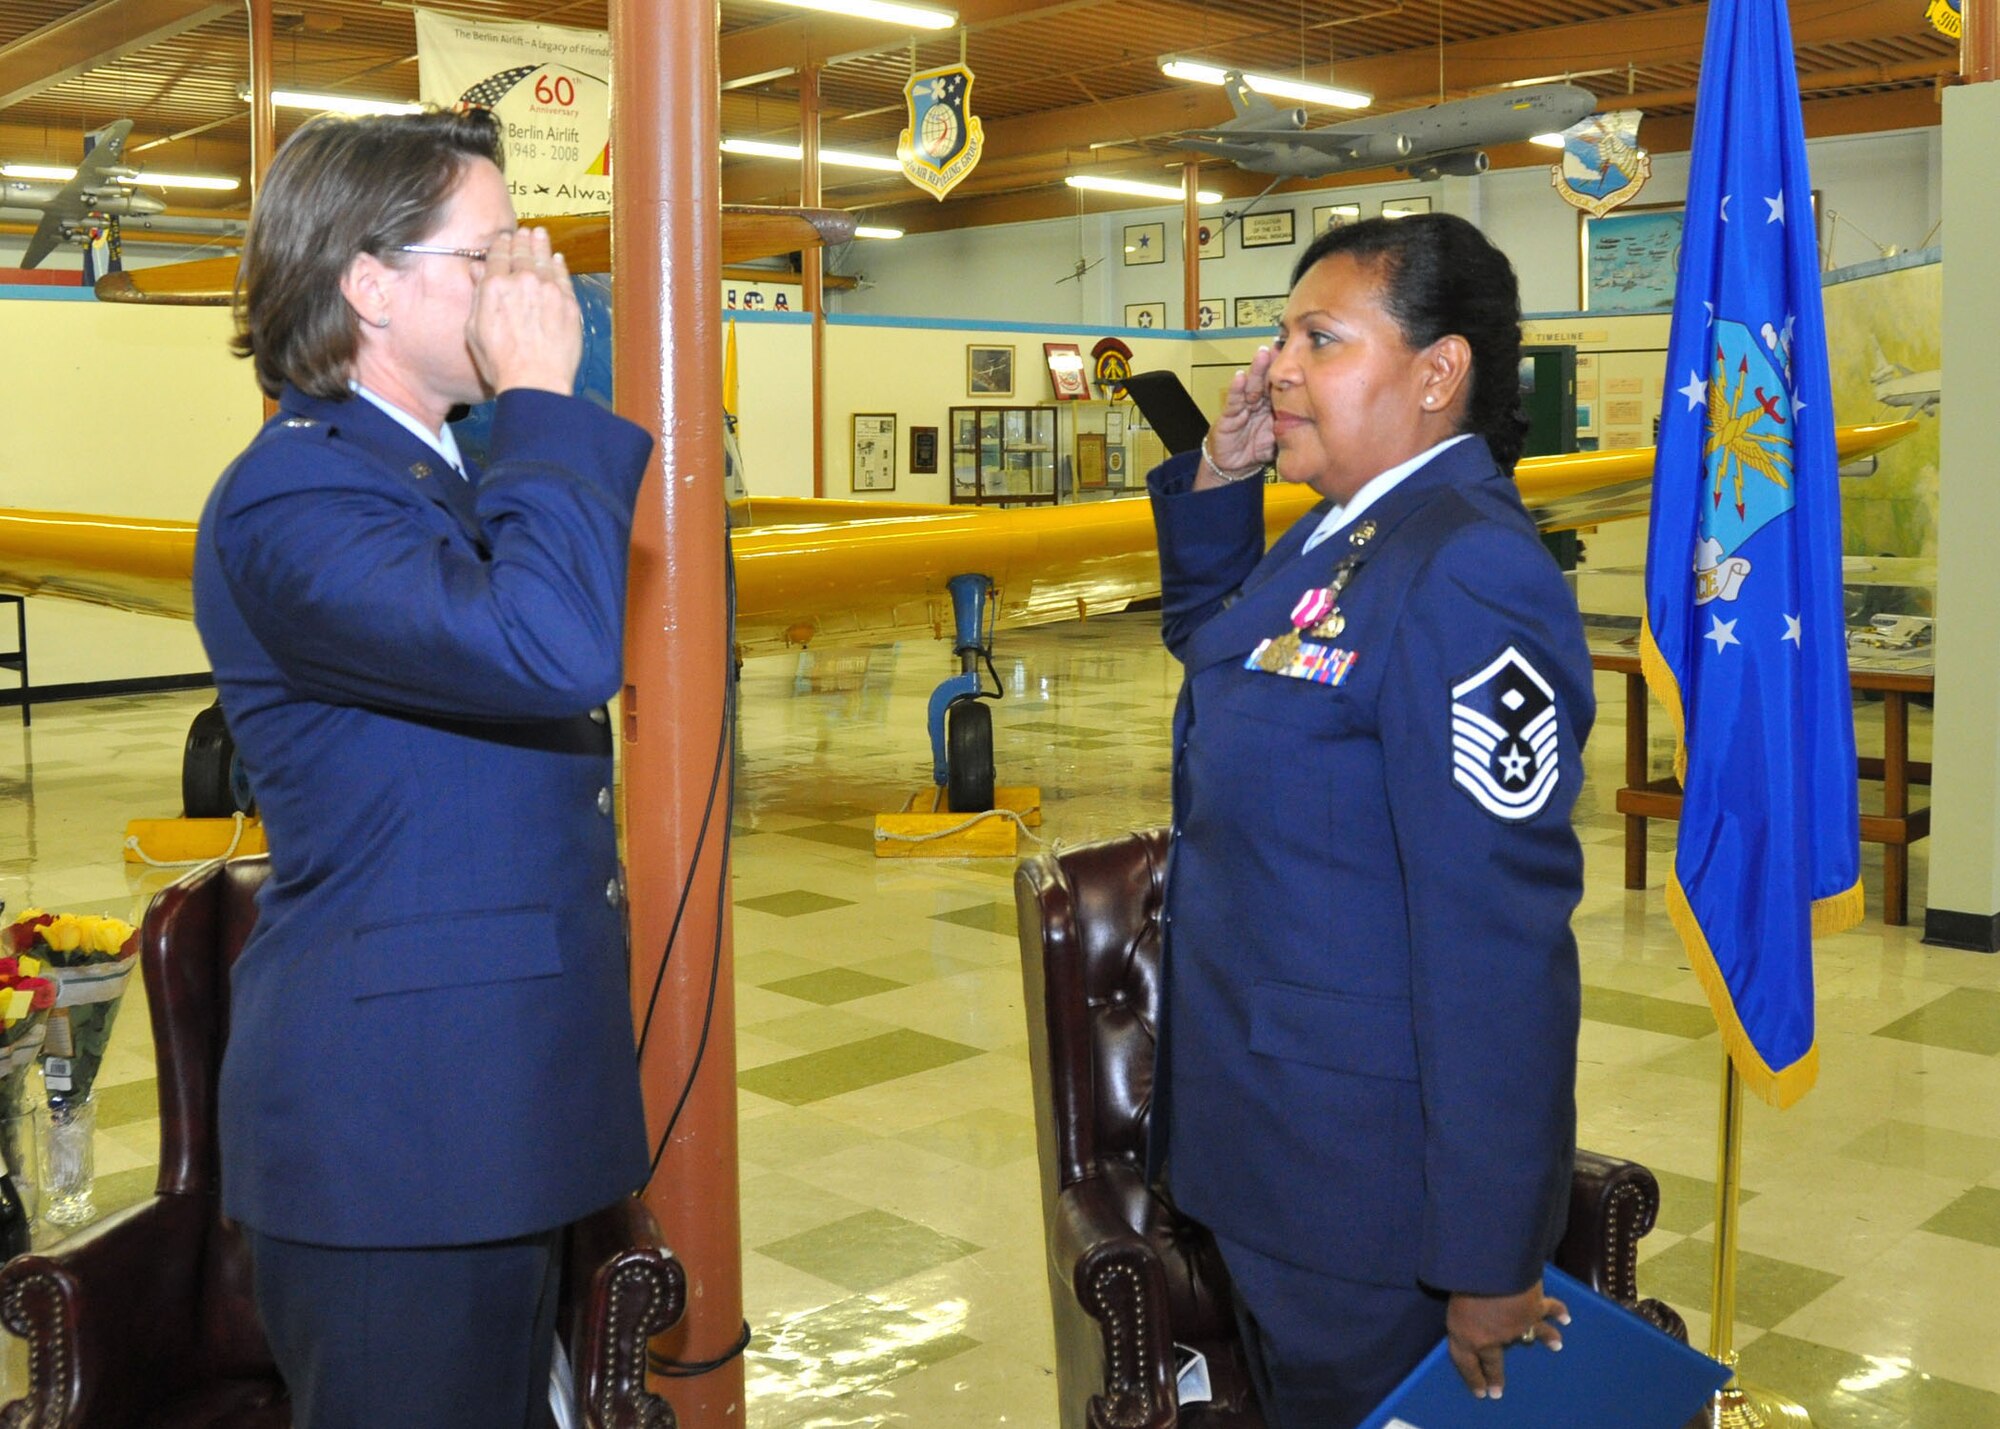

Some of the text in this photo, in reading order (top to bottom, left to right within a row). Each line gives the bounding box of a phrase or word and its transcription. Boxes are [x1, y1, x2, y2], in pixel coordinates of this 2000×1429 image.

[454, 28, 472, 40] The
[473, 30, 499, 43] Berlin
[501, 32, 524, 46] Airlift
[531, 39, 537, 47] A
[539, 40, 567, 54] Legacy
[569, 44, 579, 53] of
[529, 104, 579, 118] Anniversary
[508, 123, 579, 143] Berlin Airlift
[509, 142, 537, 159] 1948
[551, 145, 579, 161] 2008
[1536, 332, 1584, 341] TIMELINE
